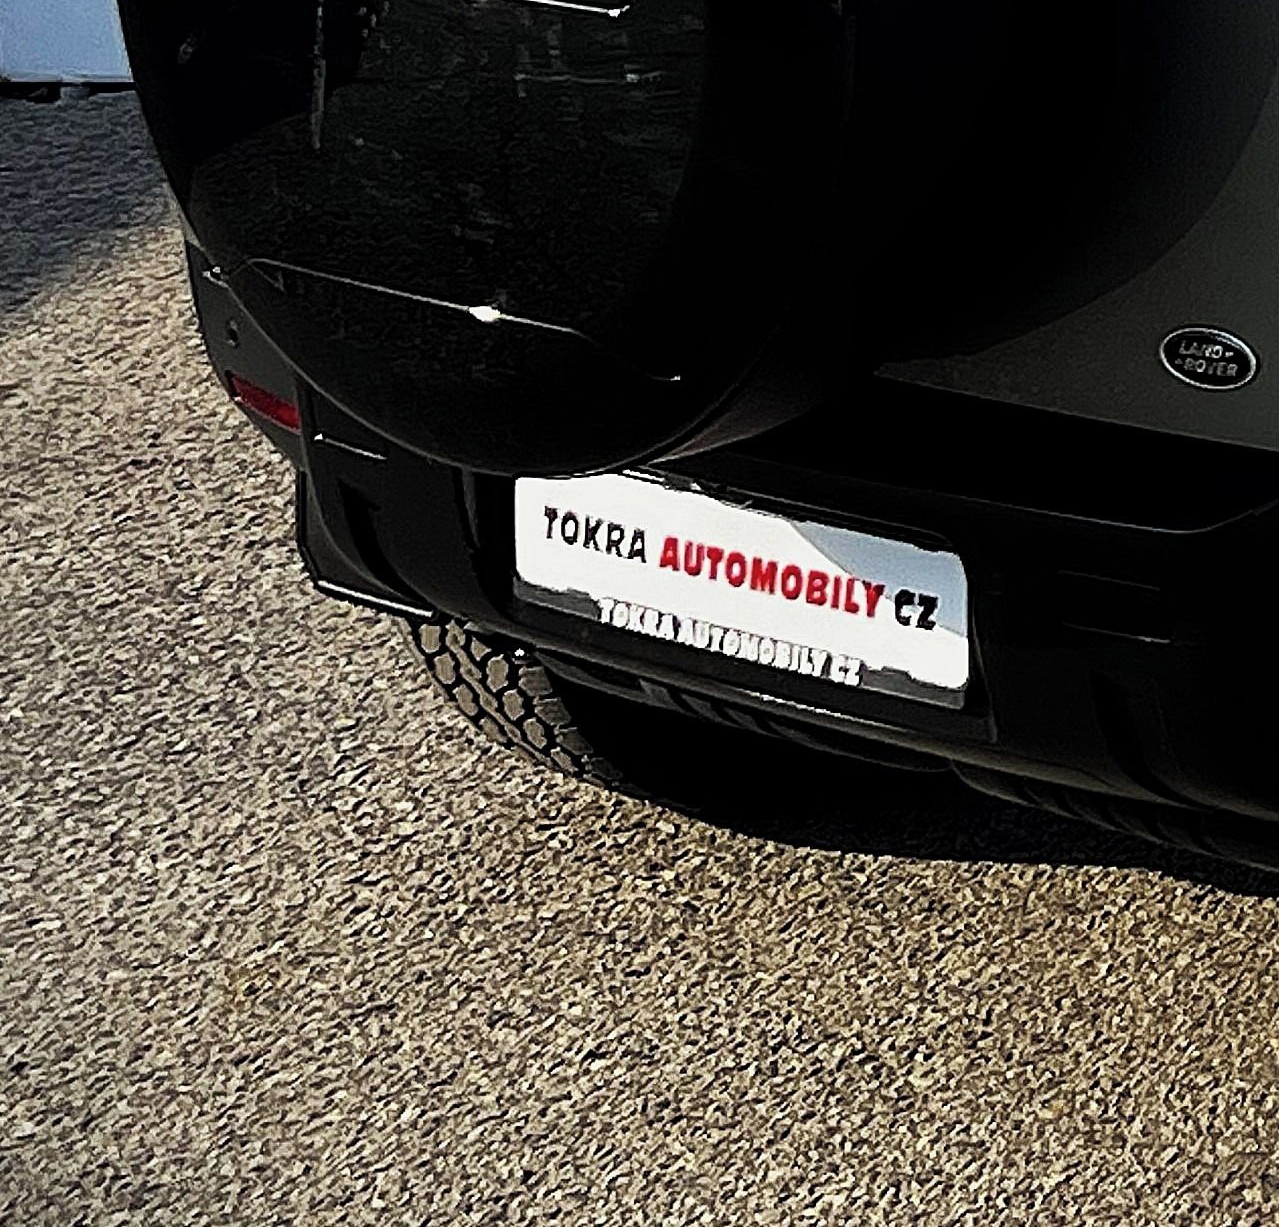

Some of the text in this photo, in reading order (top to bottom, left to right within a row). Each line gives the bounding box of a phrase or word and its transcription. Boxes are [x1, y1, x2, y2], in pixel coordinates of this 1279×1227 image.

[544, 506, 939, 630] TOKRA AUTOMOBILY CZ
[599, 597, 862, 686] TOKRA AUTOMOBILY CZ
